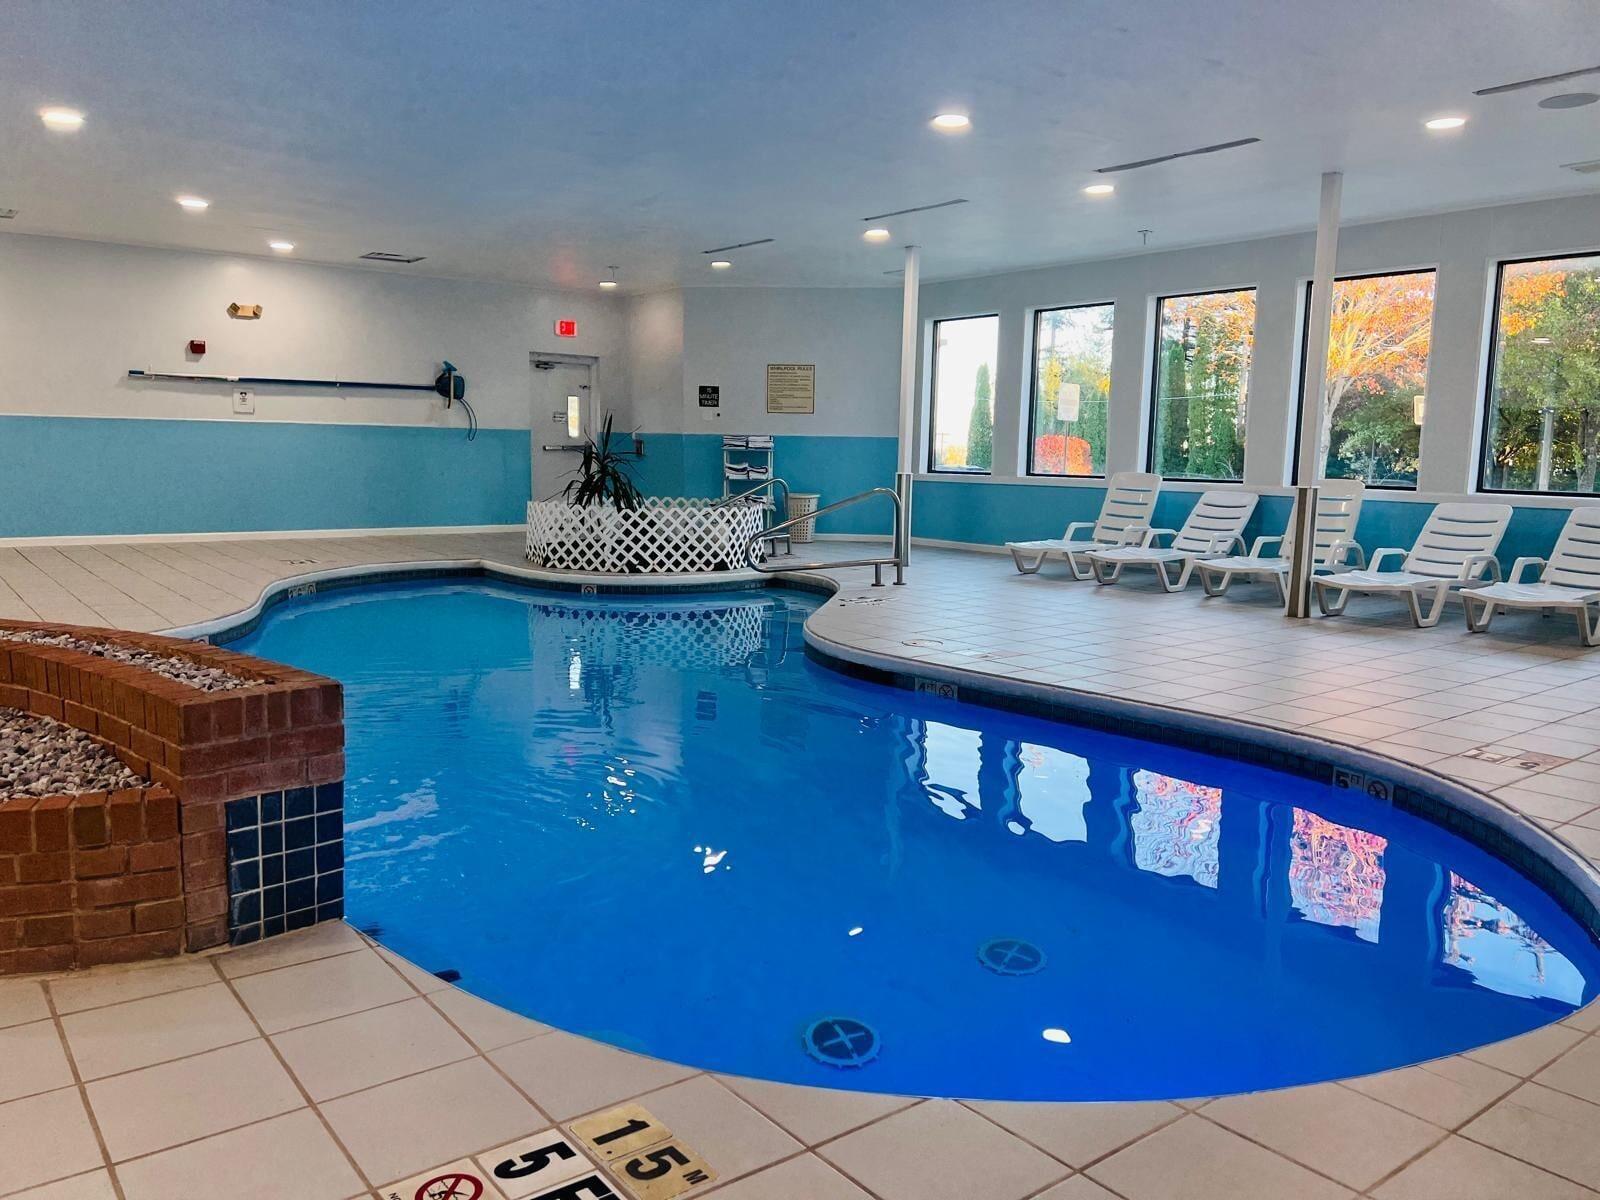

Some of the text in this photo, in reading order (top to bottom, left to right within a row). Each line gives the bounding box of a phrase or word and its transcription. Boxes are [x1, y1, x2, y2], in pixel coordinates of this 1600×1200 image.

[1336, 770, 1350, 789] 5
[494, 1141, 577, 1179] 5
[592, 1119, 709, 1185] 1.5 M
[530, 1175, 622, 1200] F
